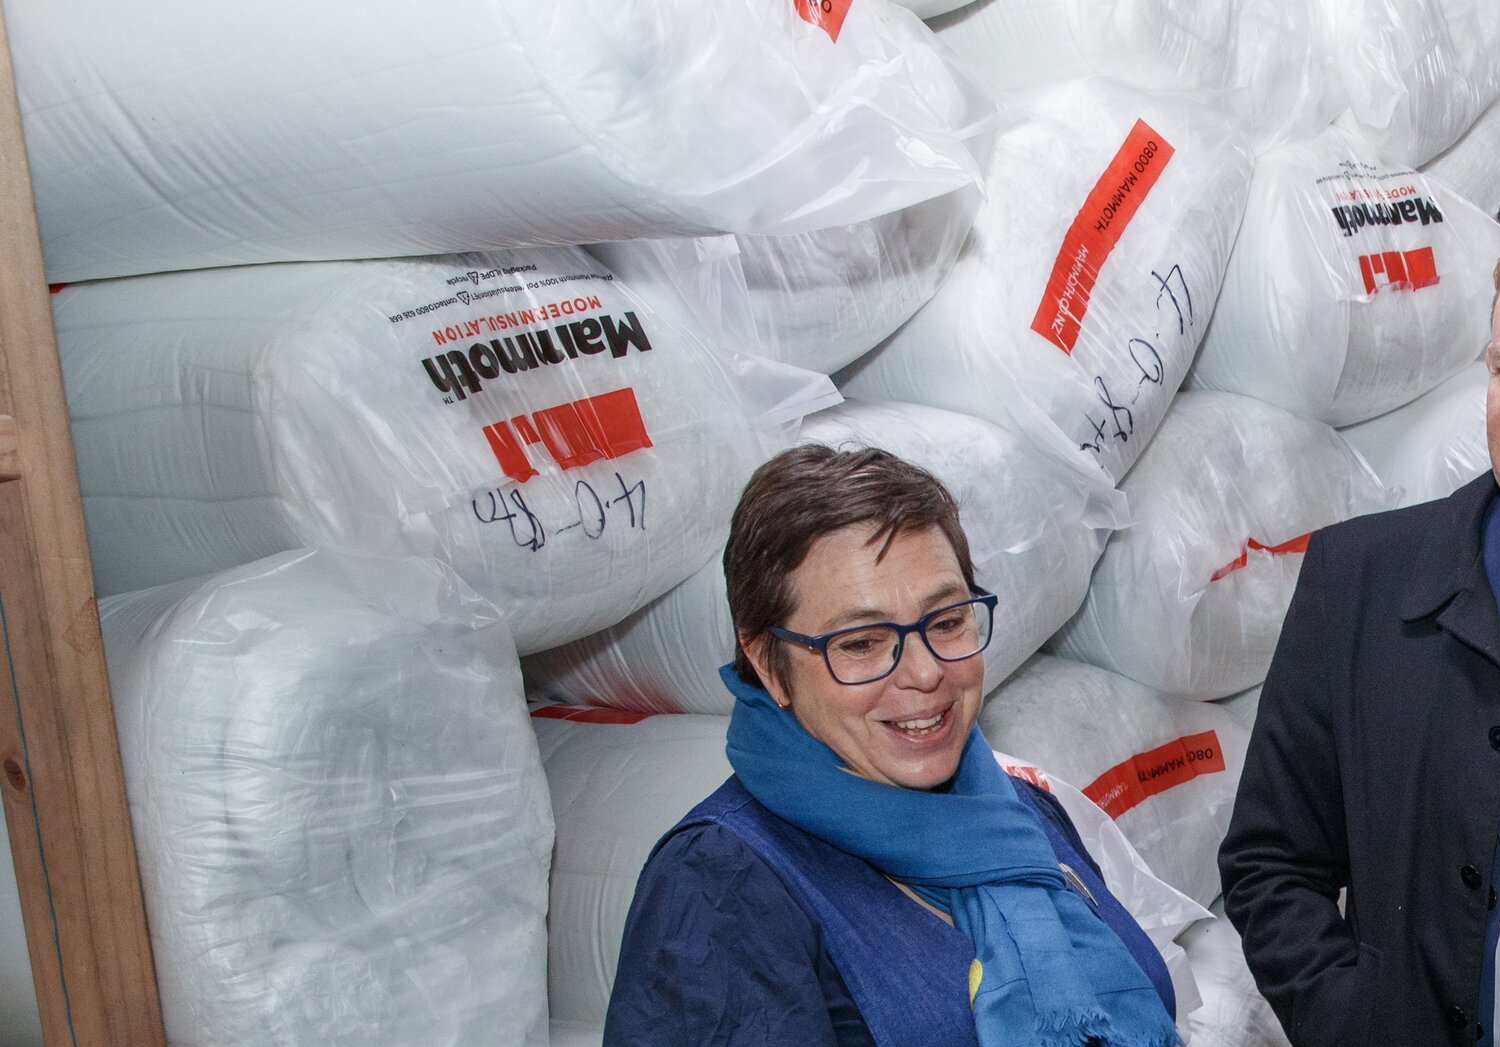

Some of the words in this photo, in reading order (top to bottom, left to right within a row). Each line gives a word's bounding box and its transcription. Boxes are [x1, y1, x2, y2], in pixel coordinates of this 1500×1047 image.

[1132, 139, 1159, 173] 0800
[1093, 171, 1138, 232] MAMMOTH
[445, 273, 469, 286] recycle
[538, 276, 559, 288] 100%
[414, 302, 434, 314] 0800
[433, 296, 458, 308] contact
[401, 308, 415, 319] 626
[422, 311, 652, 401] Mammoth
